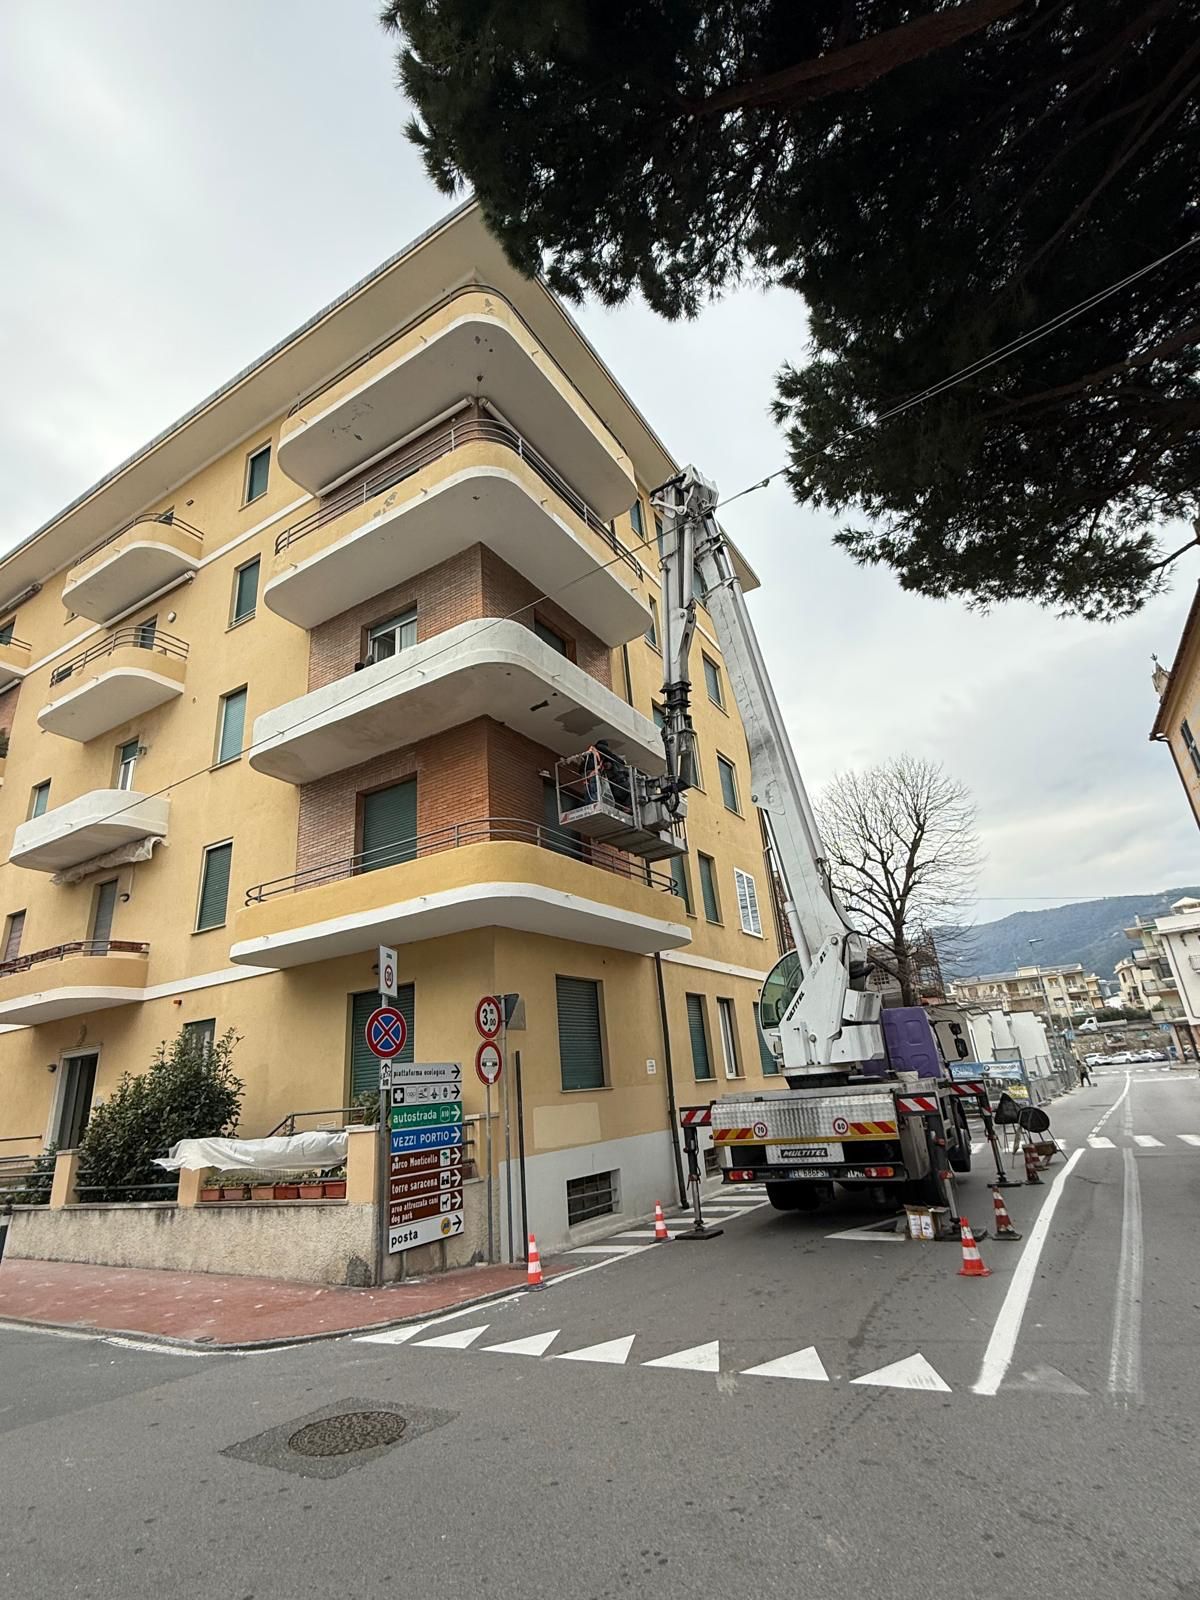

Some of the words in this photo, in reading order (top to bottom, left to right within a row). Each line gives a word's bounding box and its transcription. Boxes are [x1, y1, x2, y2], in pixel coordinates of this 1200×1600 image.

[393, 1068, 422, 1078] piattaforma
[424, 1068, 446, 1077] ecologica
[393, 1109, 437, 1123] autostrada
[757, 1126, 764, 1134] 70
[393, 1135, 417, 1147] VEZZI
[420, 1131, 449, 1143] PORTIO
[782, 1149, 826, 1157] MULTITEL
[391, 1160, 408, 1172] parco
[409, 1155, 438, 1167] Monticello
[391, 1183, 408, 1195] torre
[410, 1177, 438, 1191] saracena
[391, 1205, 403, 1214] area
[391, 1214, 401, 1224] dog
[401, 1211, 413, 1223] park
[391, 1229, 418, 1248] posta
